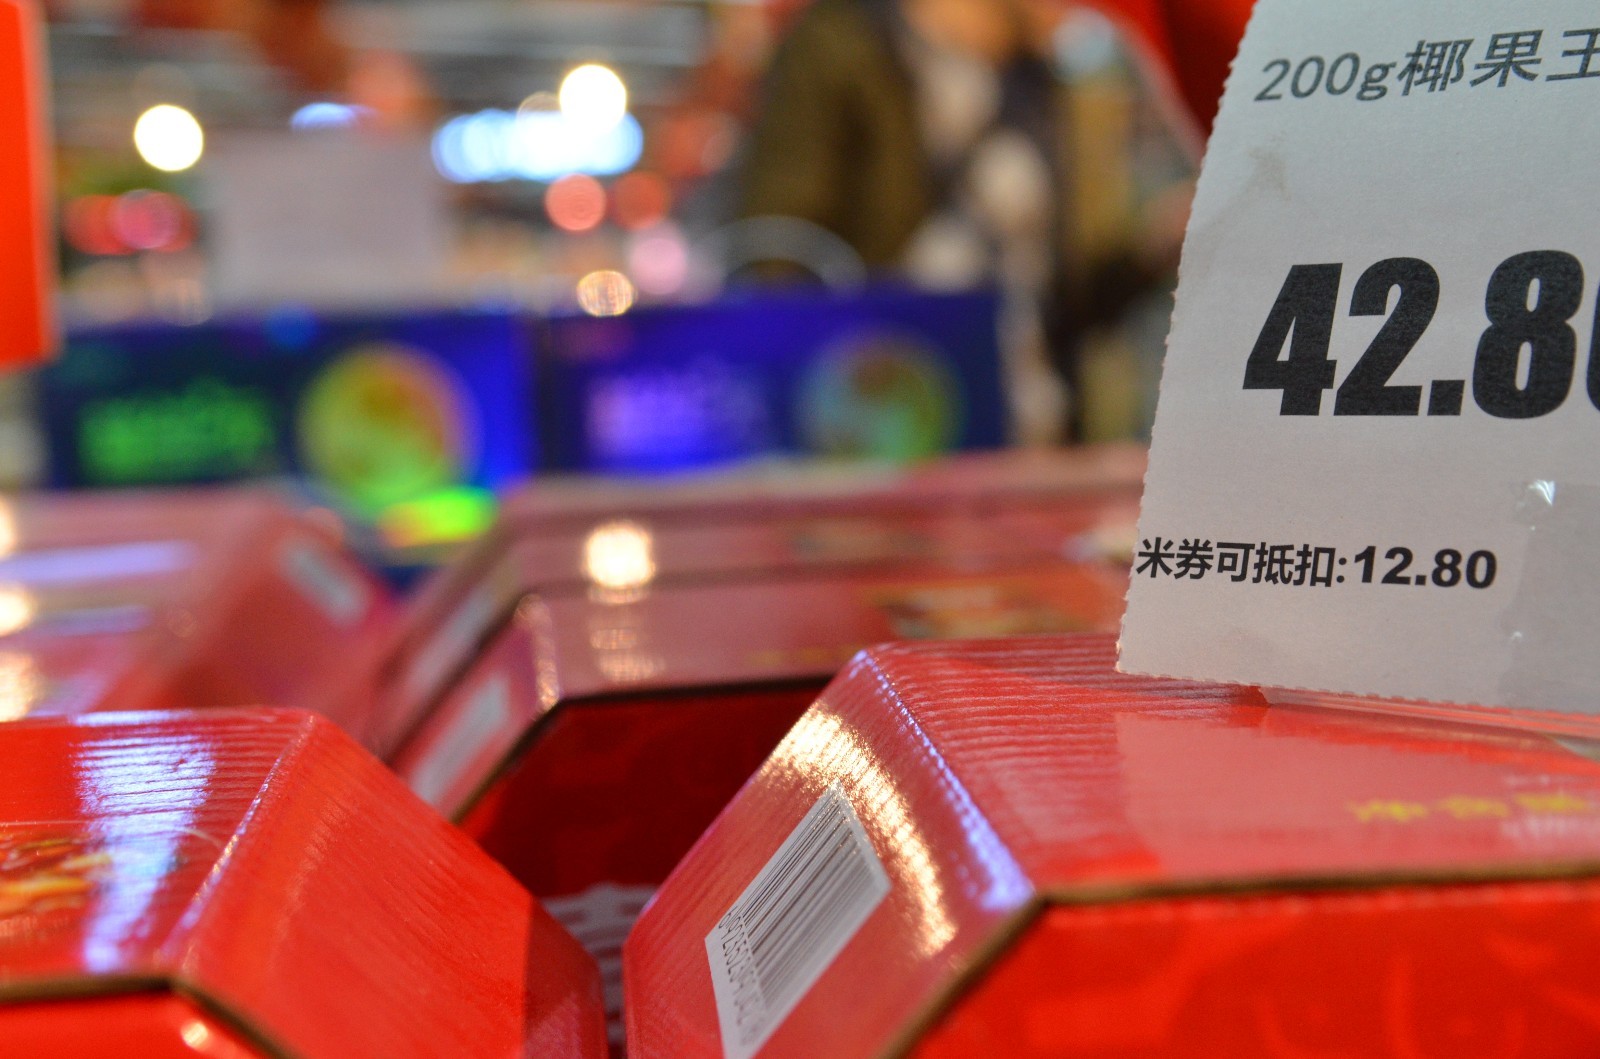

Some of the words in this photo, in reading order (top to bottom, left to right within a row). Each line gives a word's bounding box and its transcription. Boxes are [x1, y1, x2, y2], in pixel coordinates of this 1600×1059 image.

[1254, 28, 1600, 101] 200g椰果王
[1242, 249, 1600, 420] 42.8
[1136, 536, 1498, 589] 米券可抵扣:12.80
